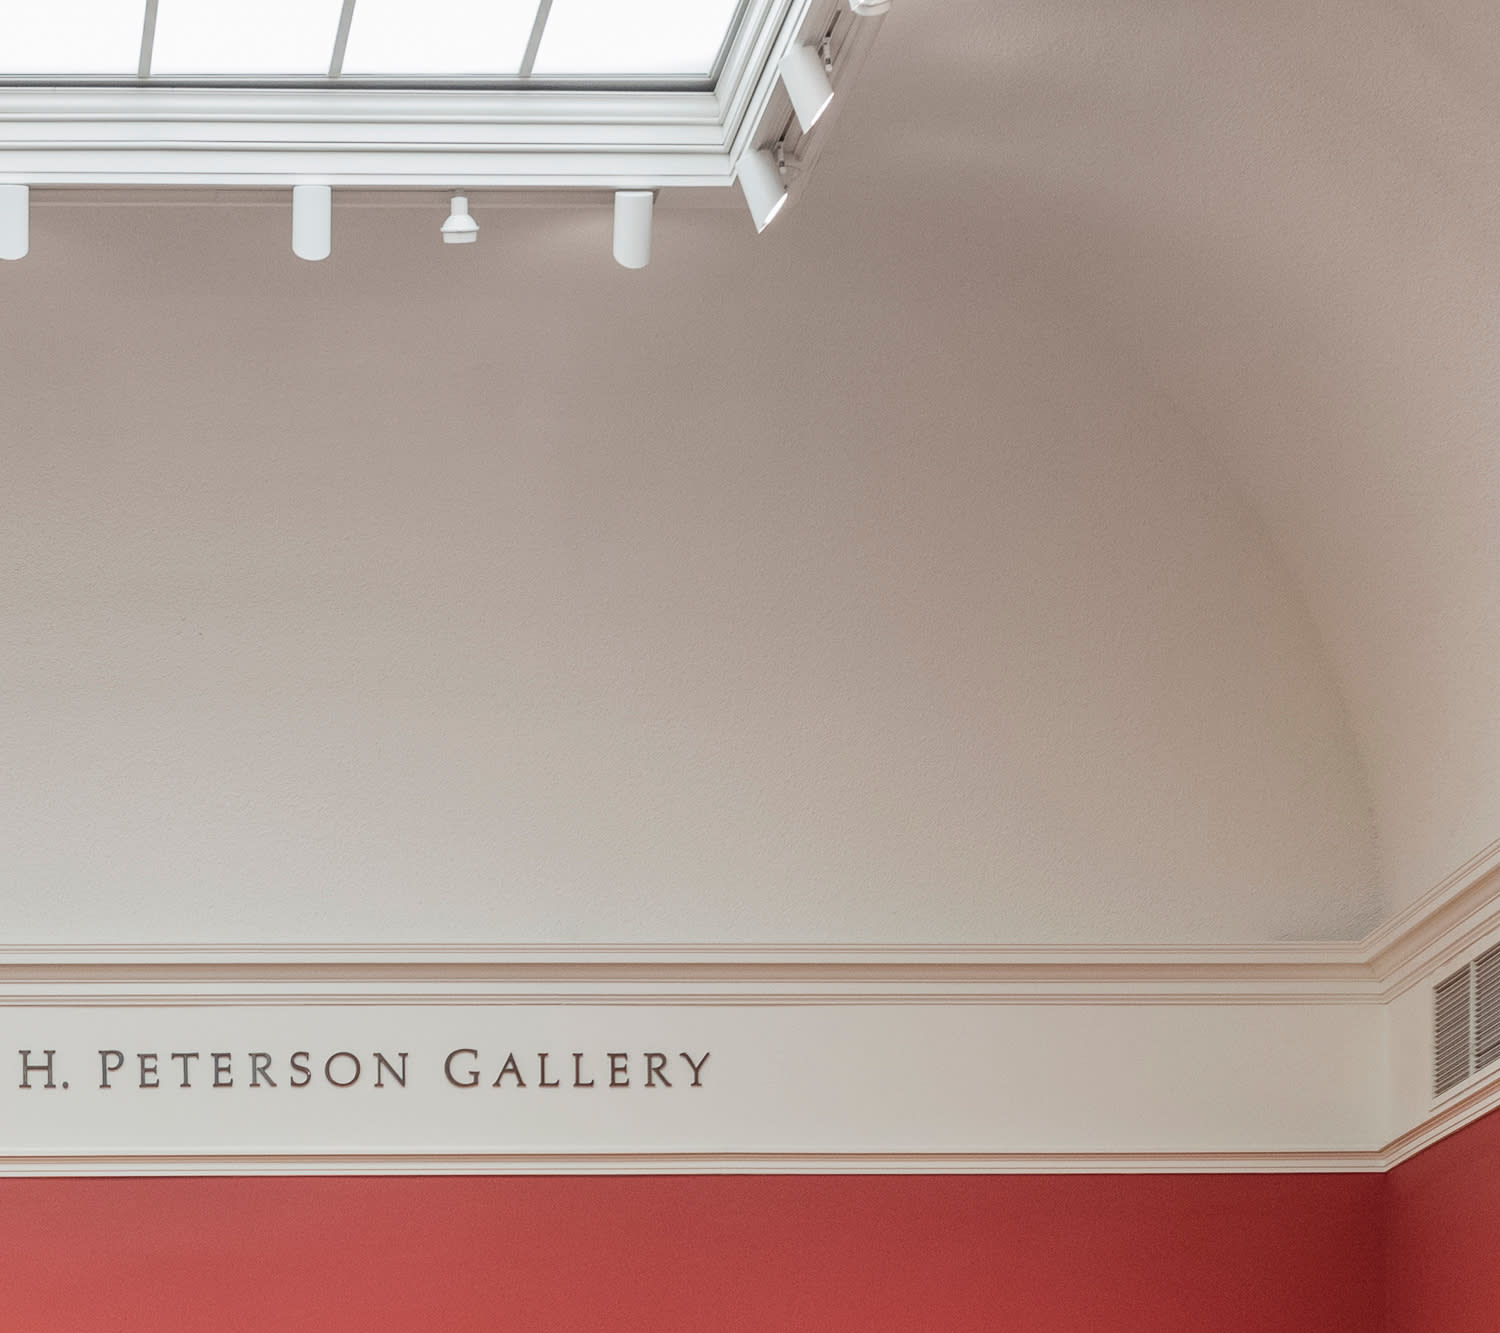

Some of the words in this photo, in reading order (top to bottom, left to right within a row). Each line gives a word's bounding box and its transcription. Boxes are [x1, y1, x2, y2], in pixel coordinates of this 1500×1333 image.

[17, 1049, 70, 1090] H.
[97, 1049, 409, 1090] PETERSON
[443, 1048, 711, 1090] GALLERY
